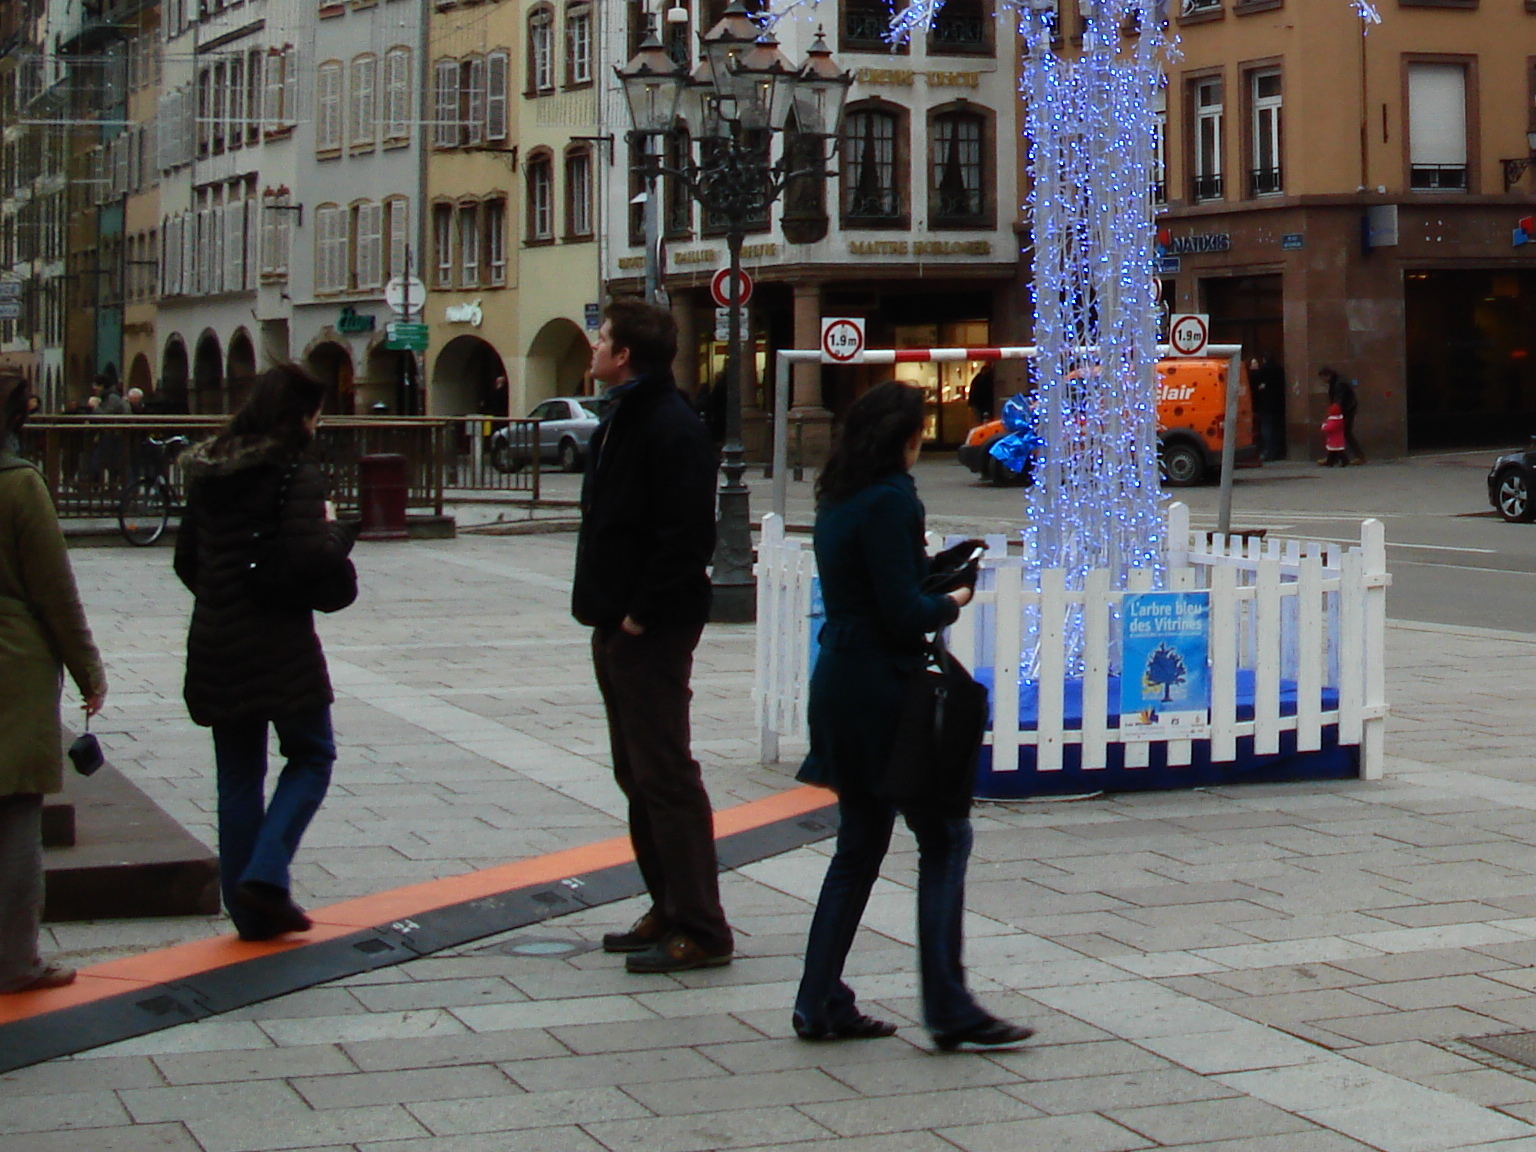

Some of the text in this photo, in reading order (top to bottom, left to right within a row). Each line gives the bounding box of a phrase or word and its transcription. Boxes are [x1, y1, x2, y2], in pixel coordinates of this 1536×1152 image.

[1130, 600, 1203, 616] L'arbre bleu
[1130, 617, 1203, 632] des Vitrines
